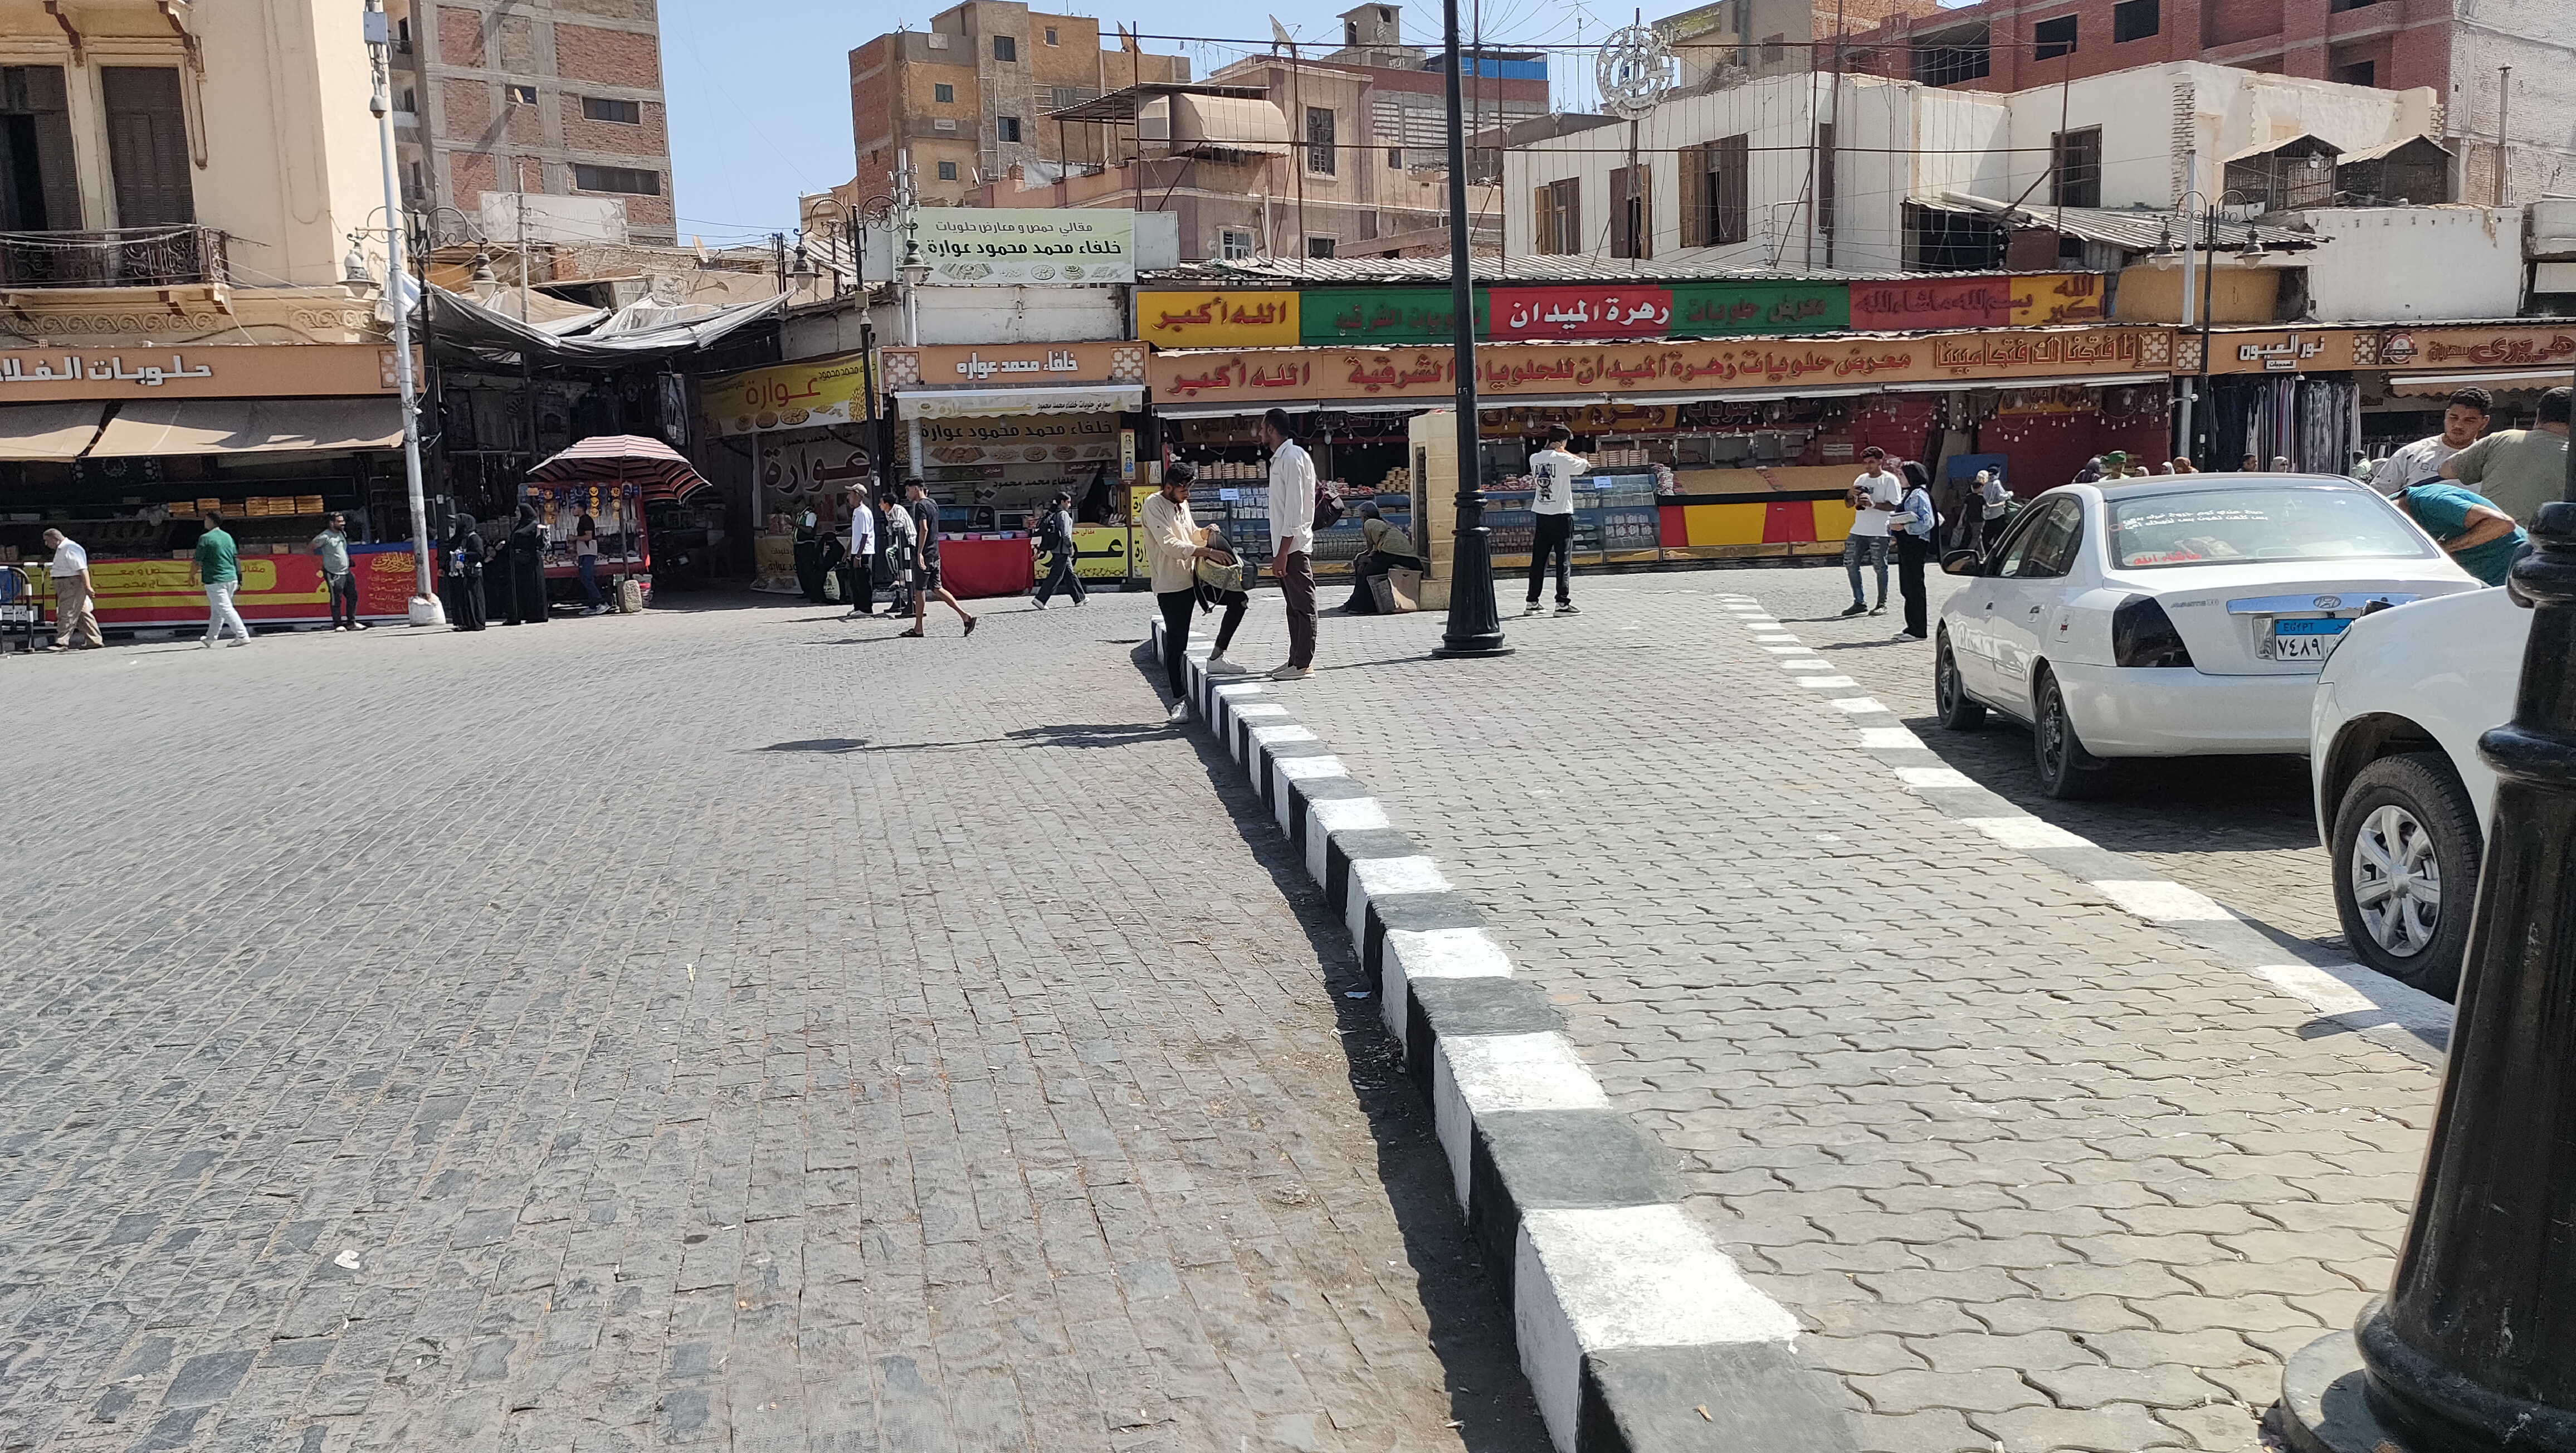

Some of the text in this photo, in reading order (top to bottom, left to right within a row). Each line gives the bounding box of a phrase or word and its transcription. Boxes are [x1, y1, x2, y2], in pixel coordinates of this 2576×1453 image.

[927, 240, 1122, 258] خلفاء محمد محمود عوارة
[1231, 301, 1286, 324] الله
[1509, 299, 1600, 330] الميدان
[2063, 335, 2116, 366] فتحنا
[2238, 334, 2325, 361] نور العيون
[0, 355, 212, 386] حلويات الفلا
[1001, 358, 1040, 372] محمد
[1043, 350, 1079, 372] خلفاء
[1165, 348, 1912, 397] معرض حلويات زهرة الميدان للحلويا الشرقية الله أكبر
[745, 377, 821, 409] عوارة
[968, 426, 1019, 440] محمود
[1024, 426, 1065, 437] محمد
[1071, 421, 1113, 435] خلفاء
[763, 447, 870, 494] عوارة
[2284, 622, 2314, 632] EGYPT
[2277, 638, 2321, 657] ٧٤٨٩
